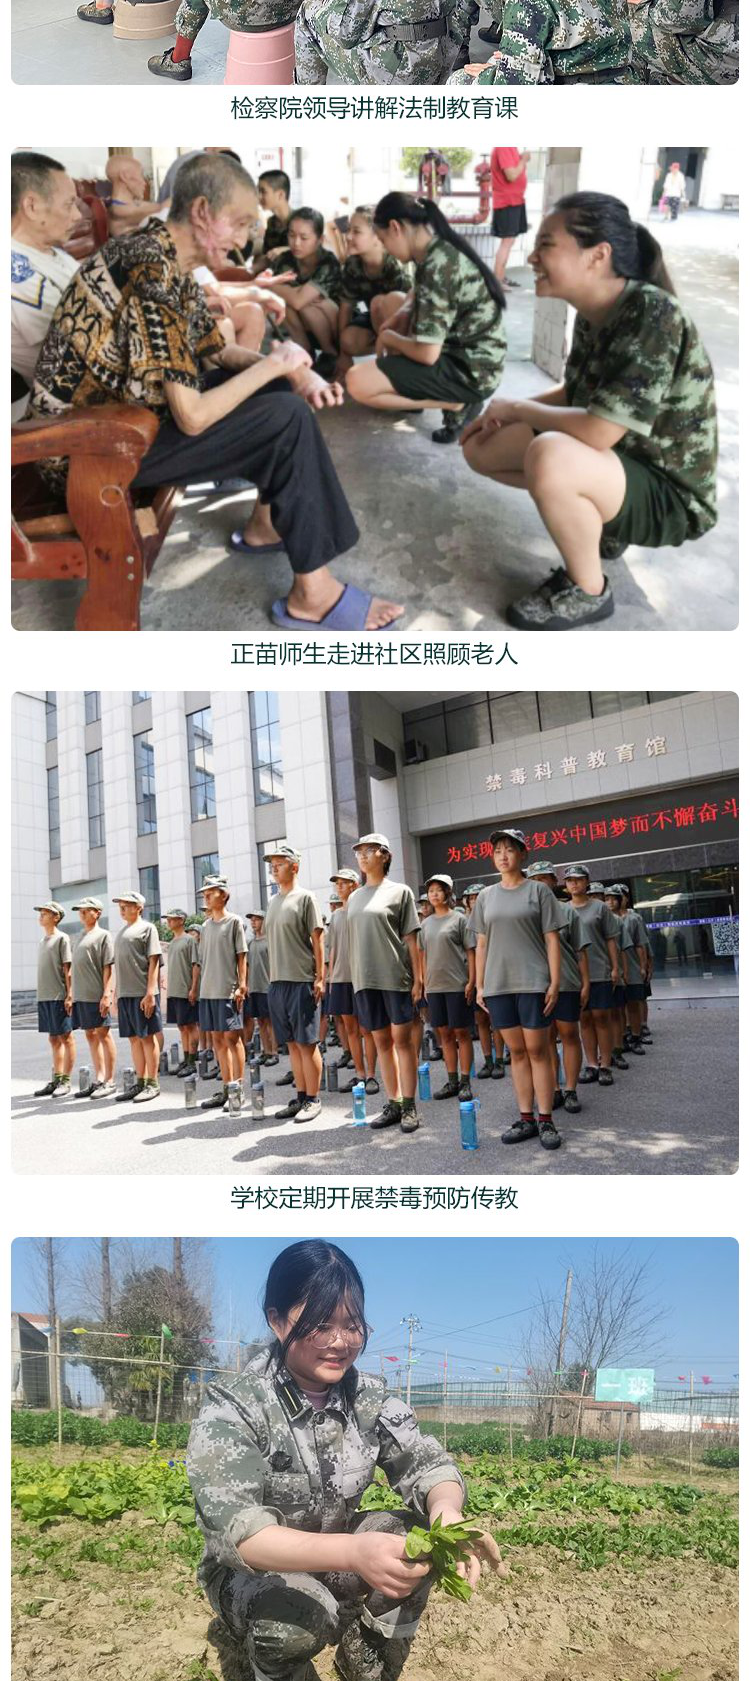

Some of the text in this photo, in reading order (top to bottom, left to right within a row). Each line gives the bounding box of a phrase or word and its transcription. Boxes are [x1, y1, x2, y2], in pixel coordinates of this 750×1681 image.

[484, 735, 668, 793] 禁毒科普教育馆
[447, 798, 740, 865] 为实现复兴中国梦而不懈奋斗
